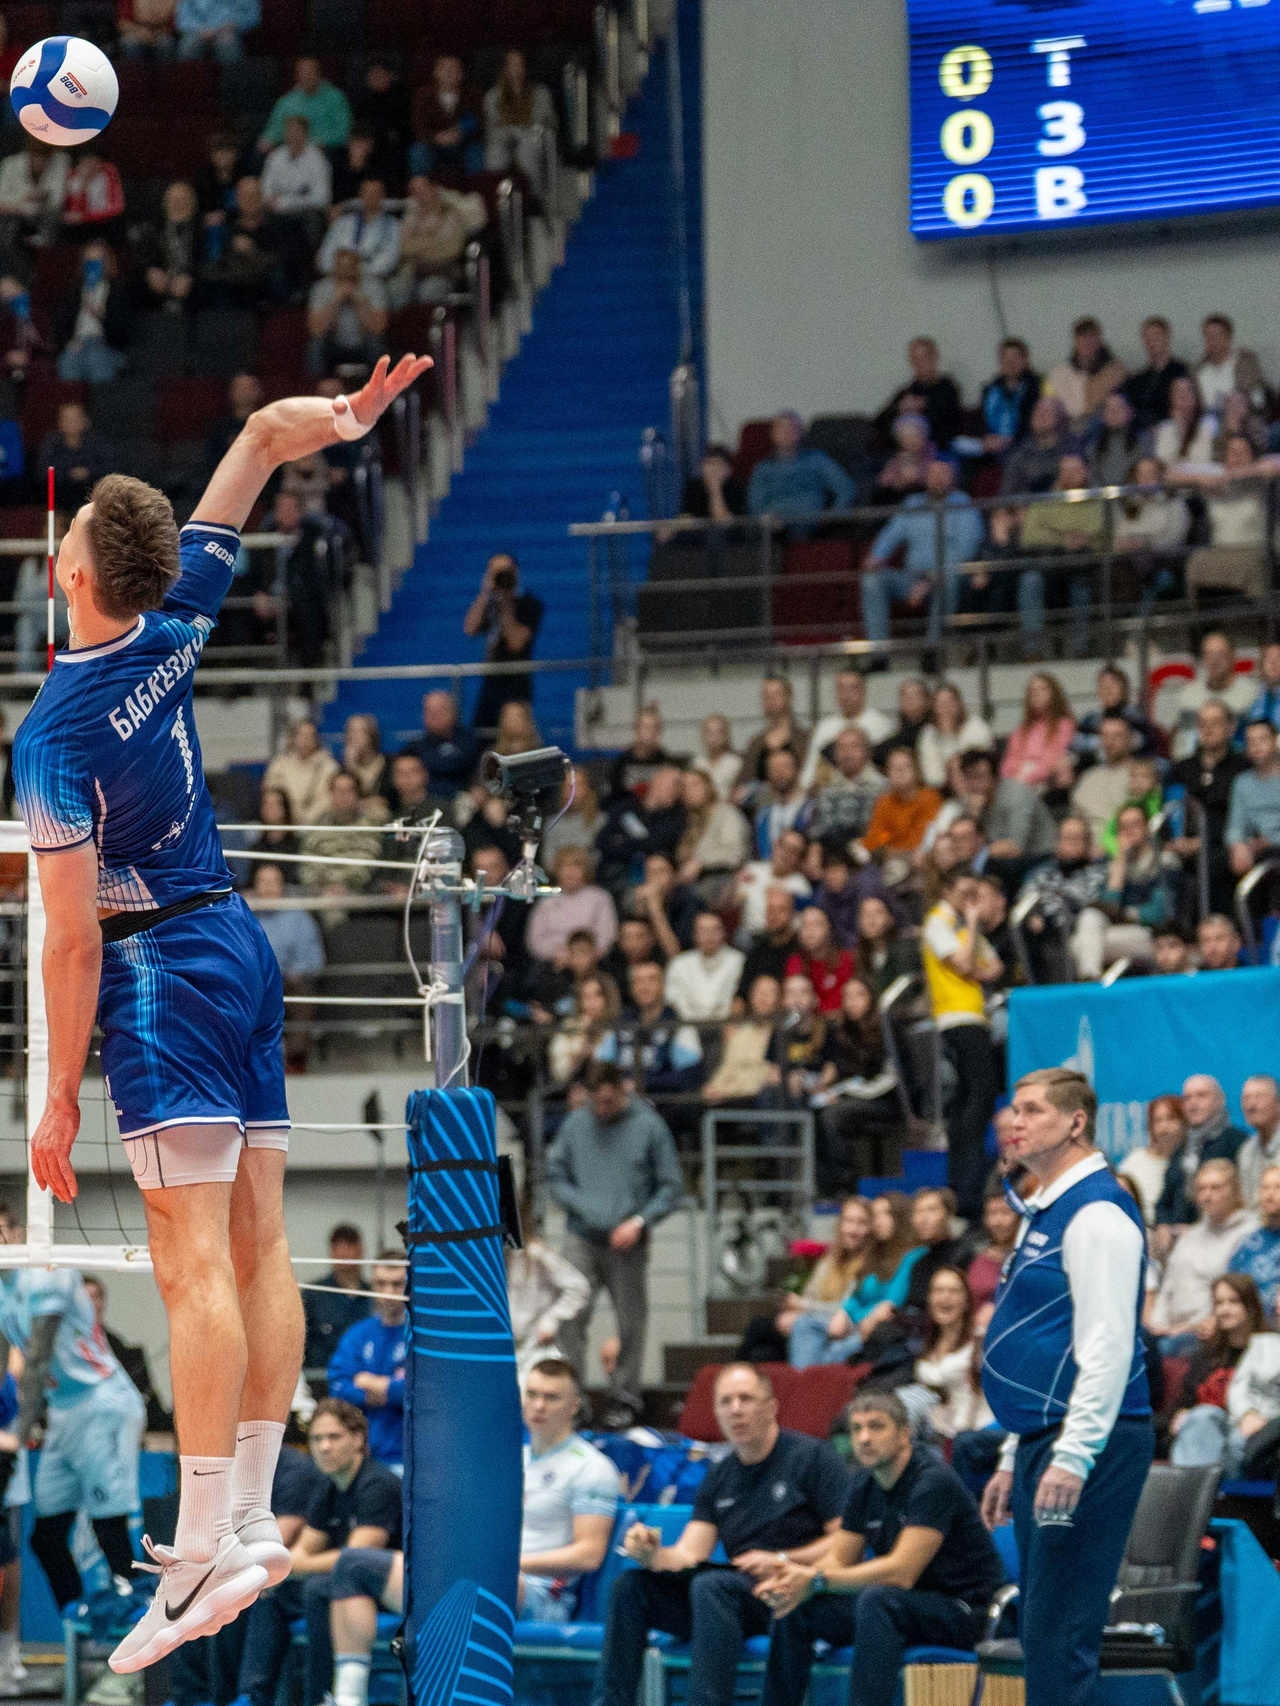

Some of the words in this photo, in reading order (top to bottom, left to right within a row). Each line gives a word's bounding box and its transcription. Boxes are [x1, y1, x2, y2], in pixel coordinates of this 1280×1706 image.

[938, 45, 994, 100] 0
[940, 109, 994, 165] 0
[942, 173, 995, 229] 0
